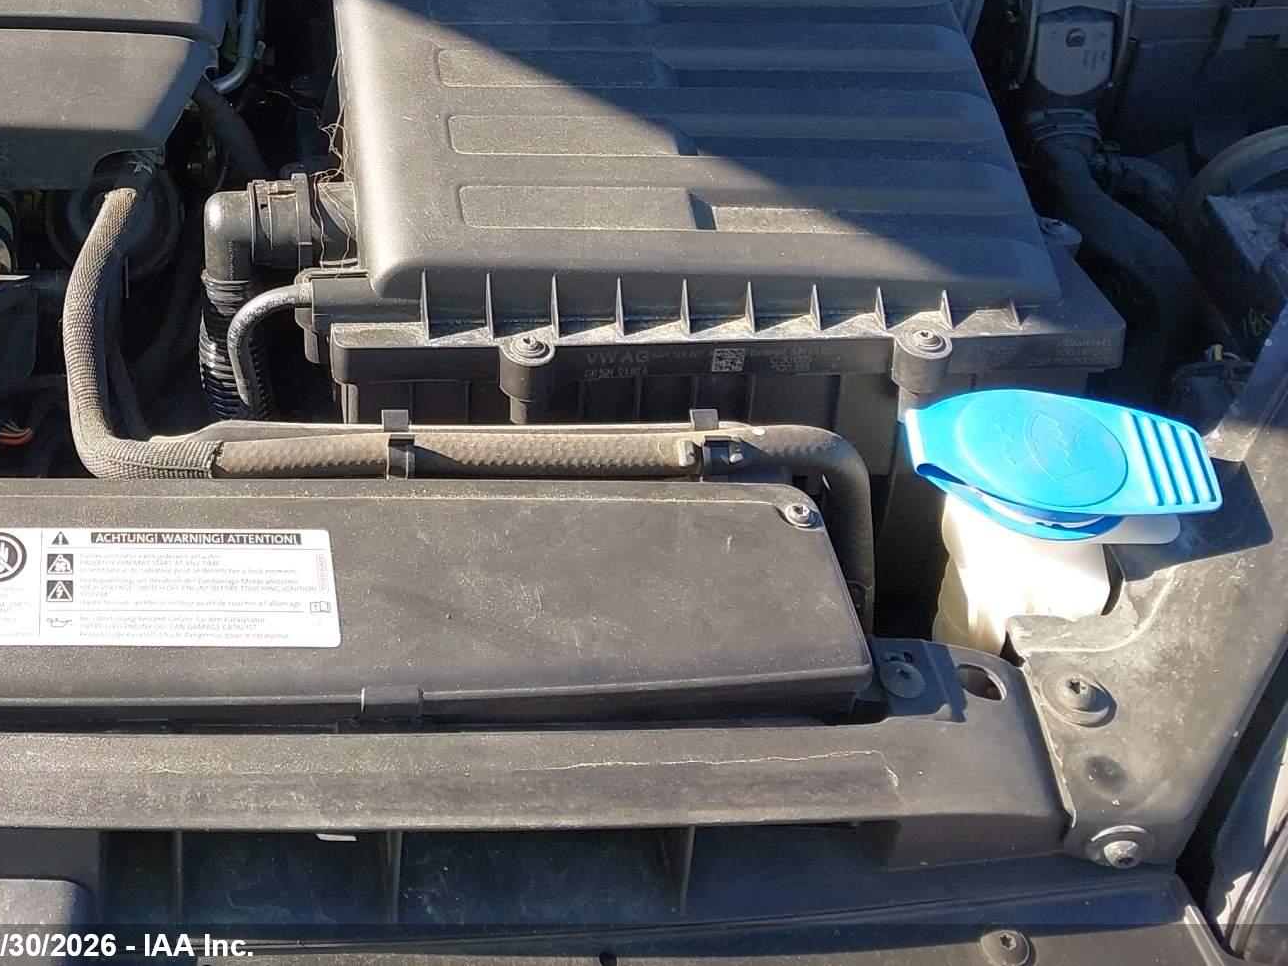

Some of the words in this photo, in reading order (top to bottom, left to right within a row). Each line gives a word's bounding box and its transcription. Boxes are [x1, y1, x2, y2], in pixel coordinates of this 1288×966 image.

[586, 352, 616, 364] VW
[620, 350, 650, 364] AG
[96, 534, 158, 543] ACHTUNG!
[162, 534, 224, 544] WARNING!
[227, 534, 298, 544] ATTENTION!
